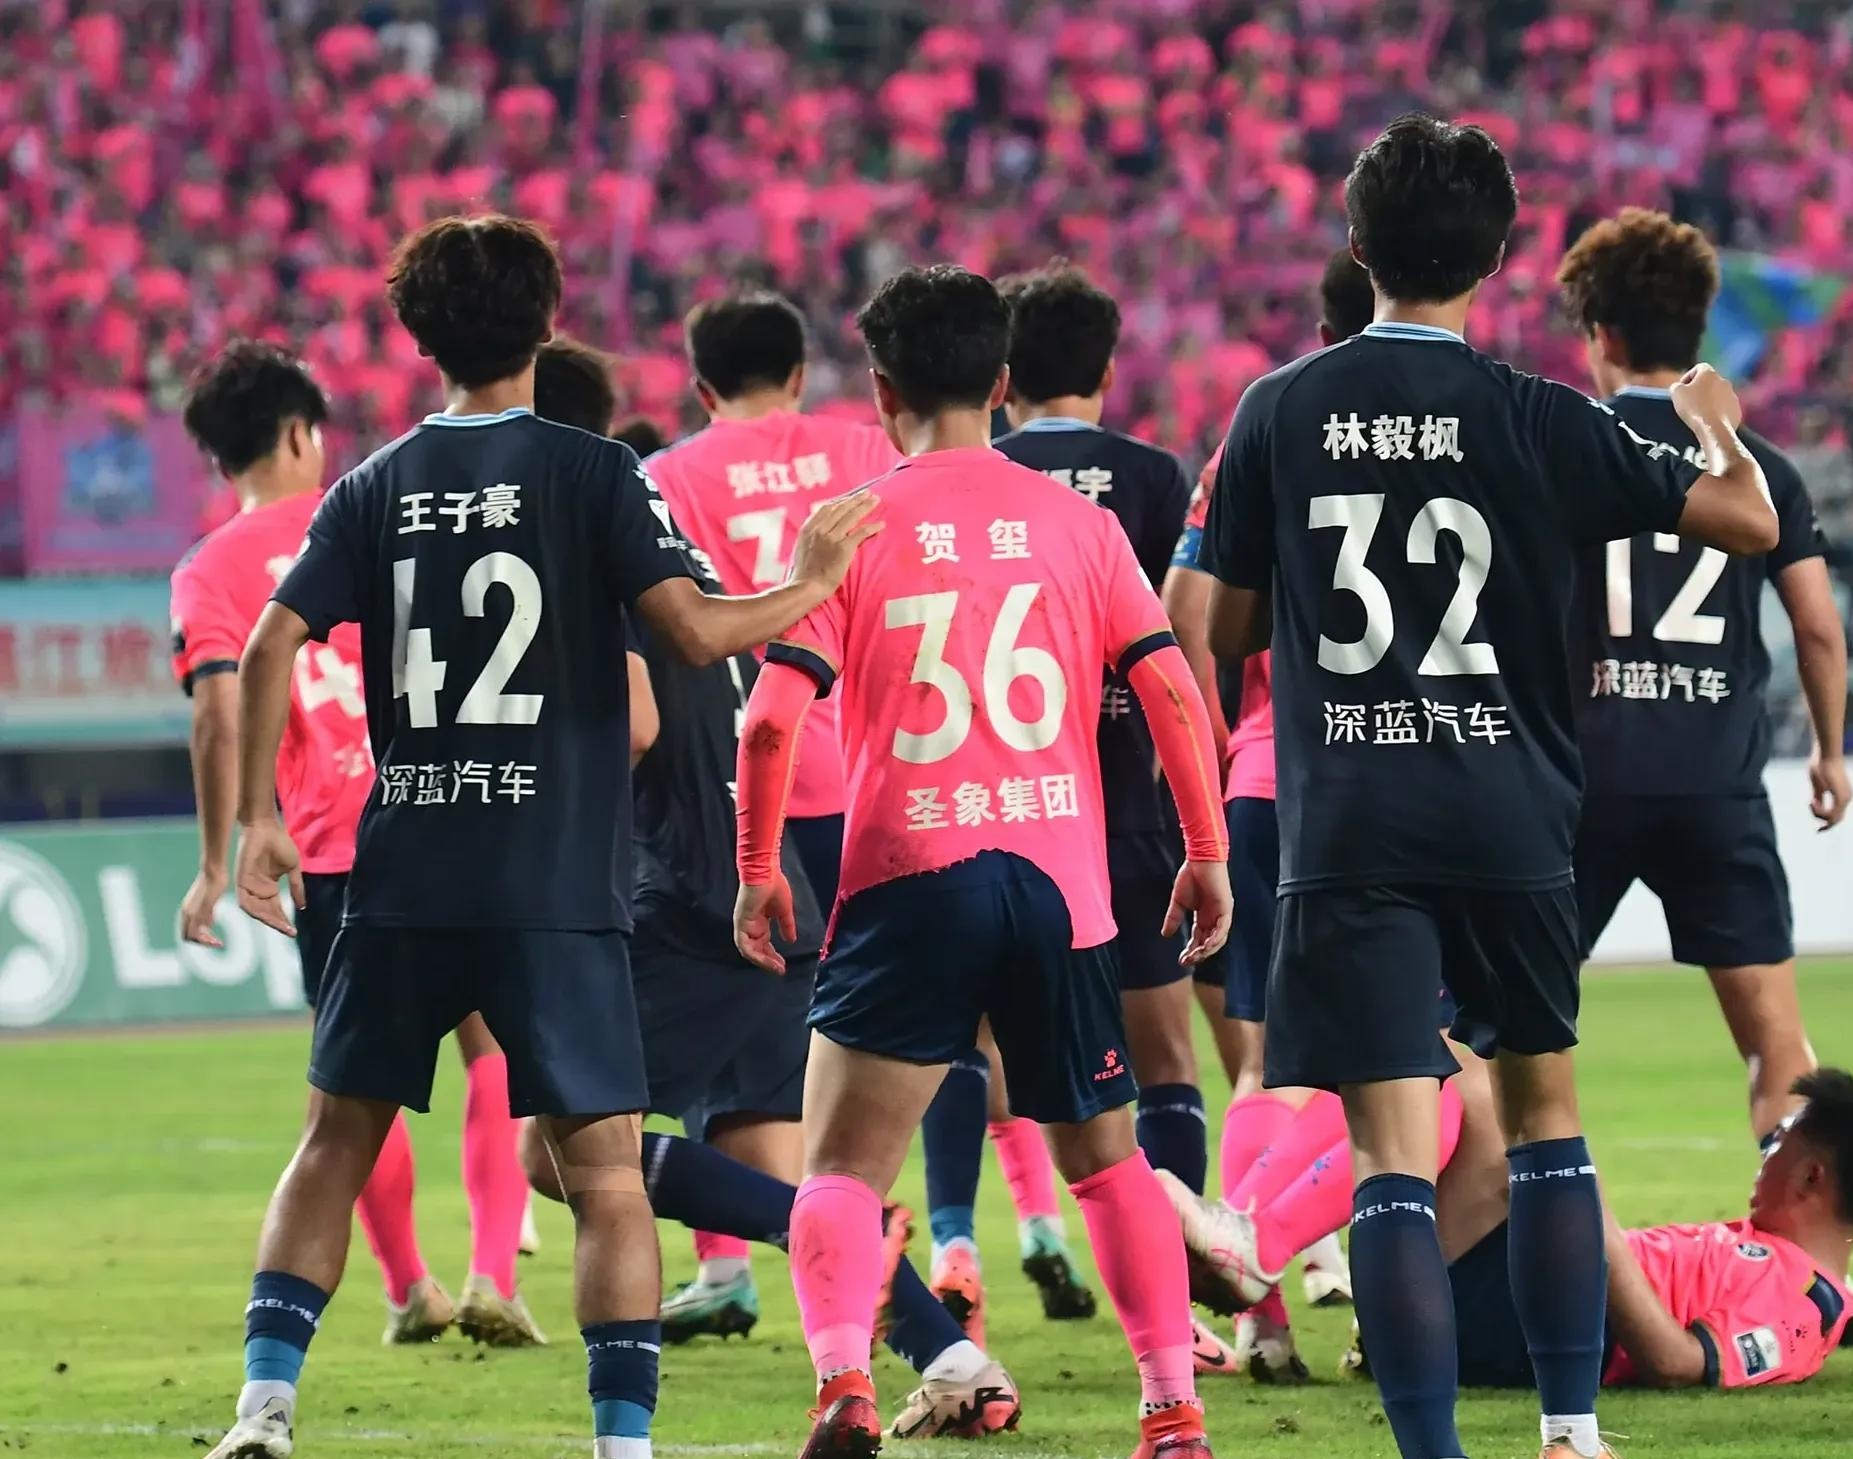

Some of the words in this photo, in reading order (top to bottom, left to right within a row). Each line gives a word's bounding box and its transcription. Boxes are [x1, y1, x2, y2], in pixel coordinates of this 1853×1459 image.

[1322, 412, 1465, 463] 林毅枫
[397, 483, 521, 535] 王子豪
[1307, 494, 1500, 677] 32
[1606, 531, 1729, 645] 12
[392, 551, 545, 729] 42
[885, 583, 1067, 764] 36
[1591, 658, 1731, 704] 深蓝汽车
[1323, 698, 1512, 746] 深蓝汽车
[380, 760, 538, 805] 深蓝汽车
[904, 773, 1080, 831] 圣象集团
[1093, 1065, 1124, 1081] KELME
[1509, 1167, 1577, 1184] KELME
[1355, 1202, 1422, 1223] KELME
